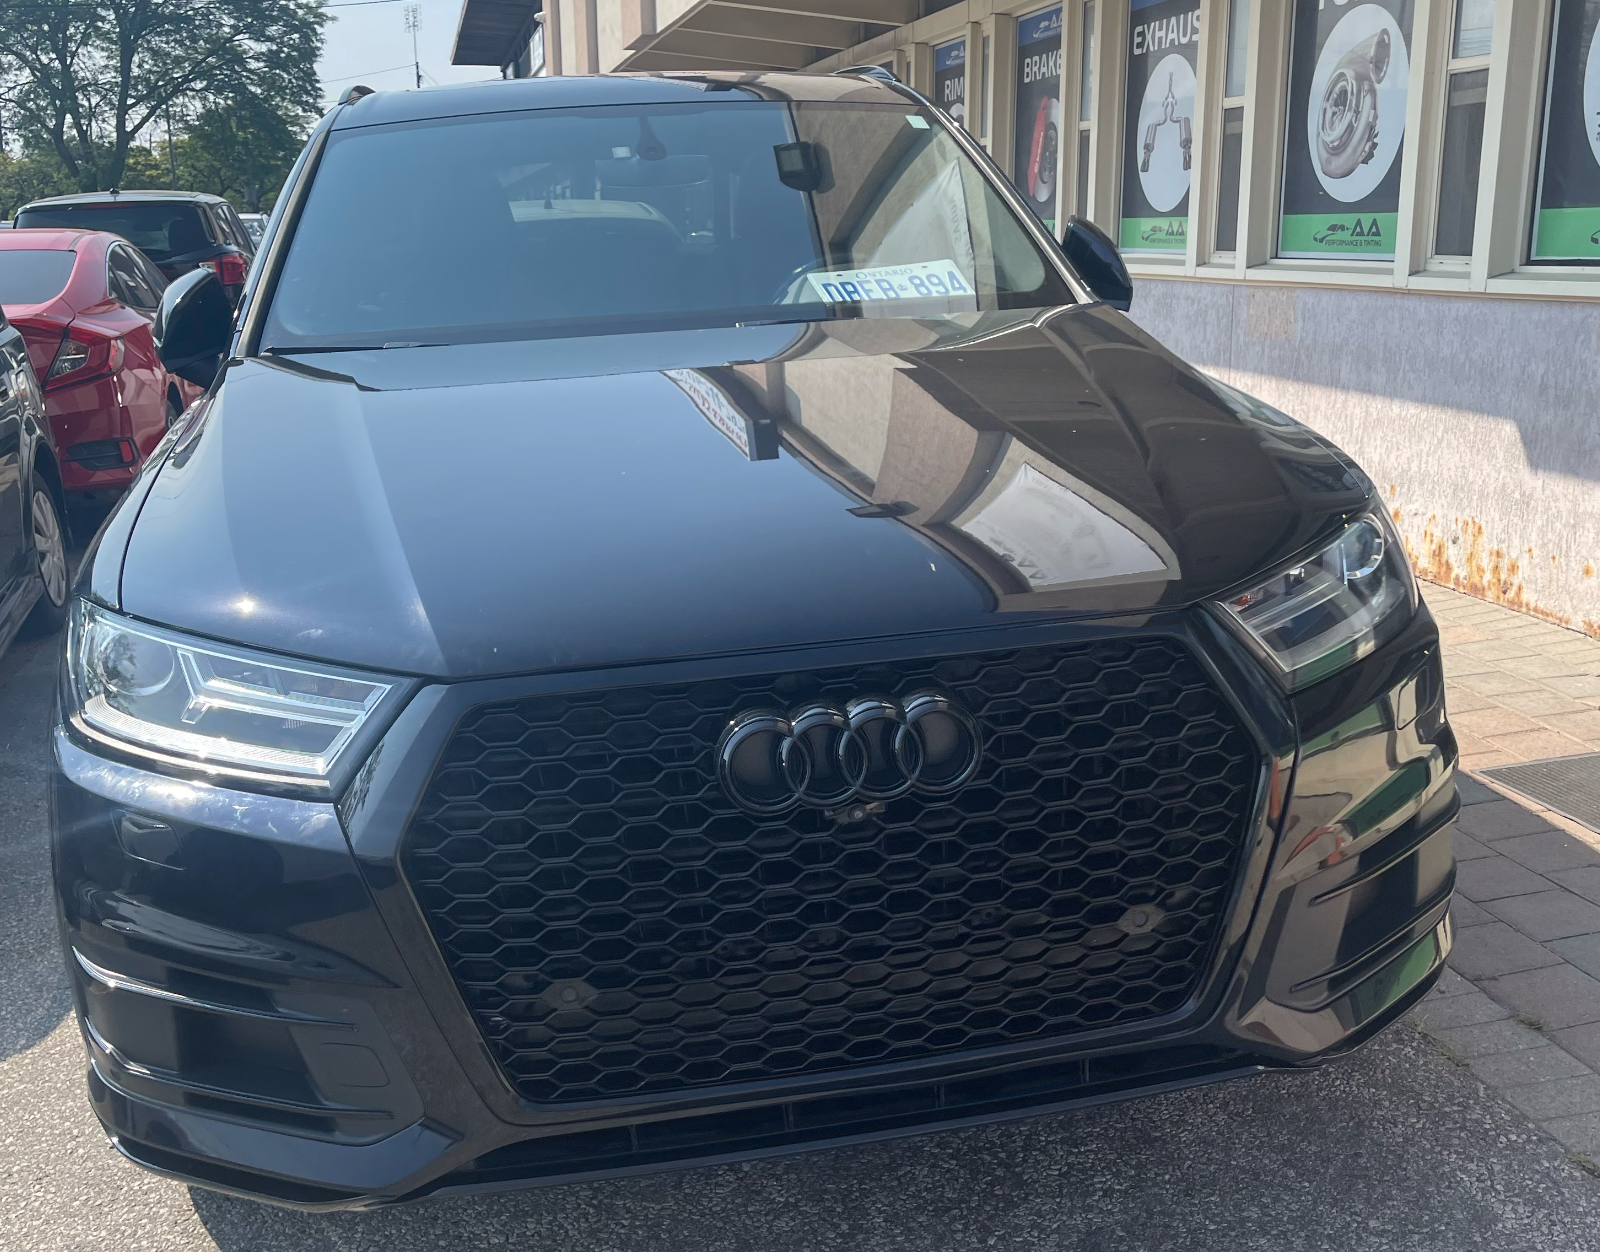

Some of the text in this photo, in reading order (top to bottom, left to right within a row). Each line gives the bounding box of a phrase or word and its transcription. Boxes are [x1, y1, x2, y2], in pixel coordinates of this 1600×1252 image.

[1165, 220, 1185, 236] AA
[1350, 217, 1382, 237] AA
[1324, 239, 1358, 247] PERFORMANCE
[1363, 239, 1382, 247] TINTING
[855, 267, 914, 280] ONTARIO
[908, 270, 968, 297] 894
